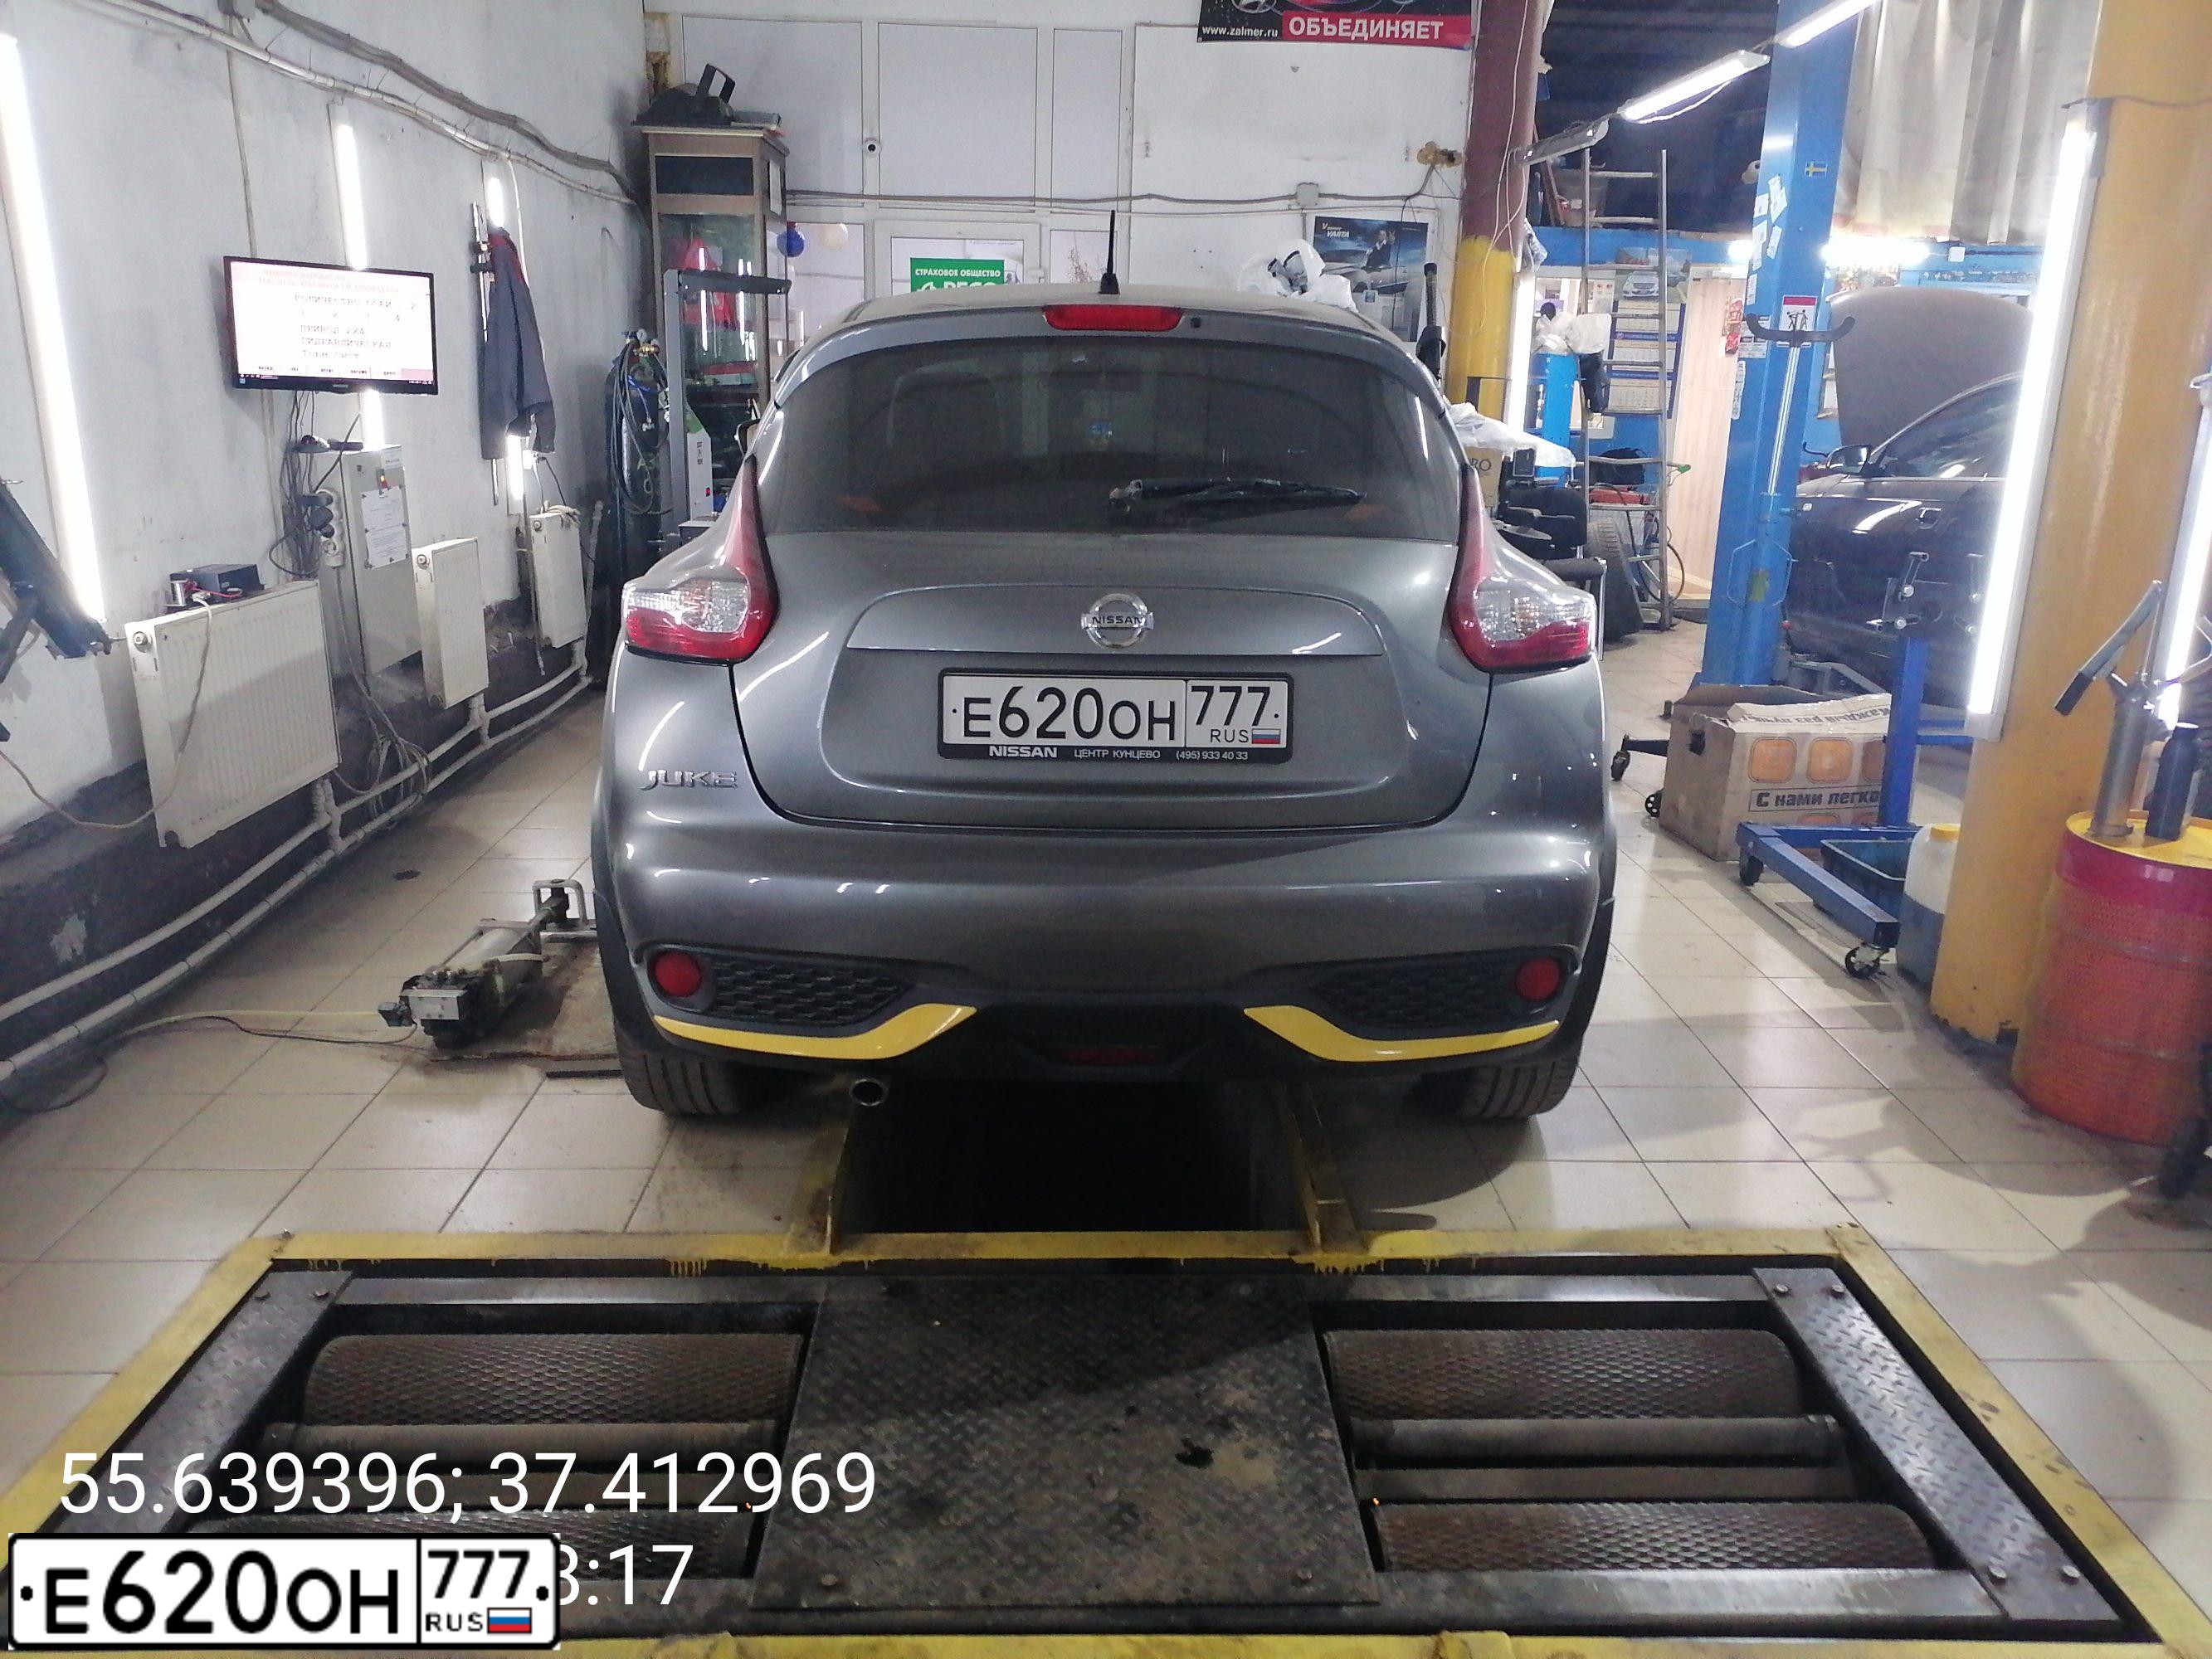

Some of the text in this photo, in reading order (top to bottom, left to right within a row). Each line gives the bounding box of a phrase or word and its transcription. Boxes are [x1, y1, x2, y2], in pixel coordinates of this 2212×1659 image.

[1202, 26, 1279, 38] www.zalmer.ru
[1289, 17, 1445, 41] ОБЪЕДИНЯЕТ
[1327, 230, 1350, 239] VARTA
[914, 268, 1001, 278] СТРАХОВОЕ ОБЩЕСТВО
[1092, 615, 1144, 625] NISSAN
[1191, 685, 1271, 726] 777
[1210, 729, 1249, 743] RUS
[989, 746, 1249, 761] NISSAN ЦЕНТР КУНЦЕВО (495) 933 40 33
[641, 769, 738, 791] JUKE
[1756, 792, 1771, 807] С
[1775, 792, 1823, 807] нами
